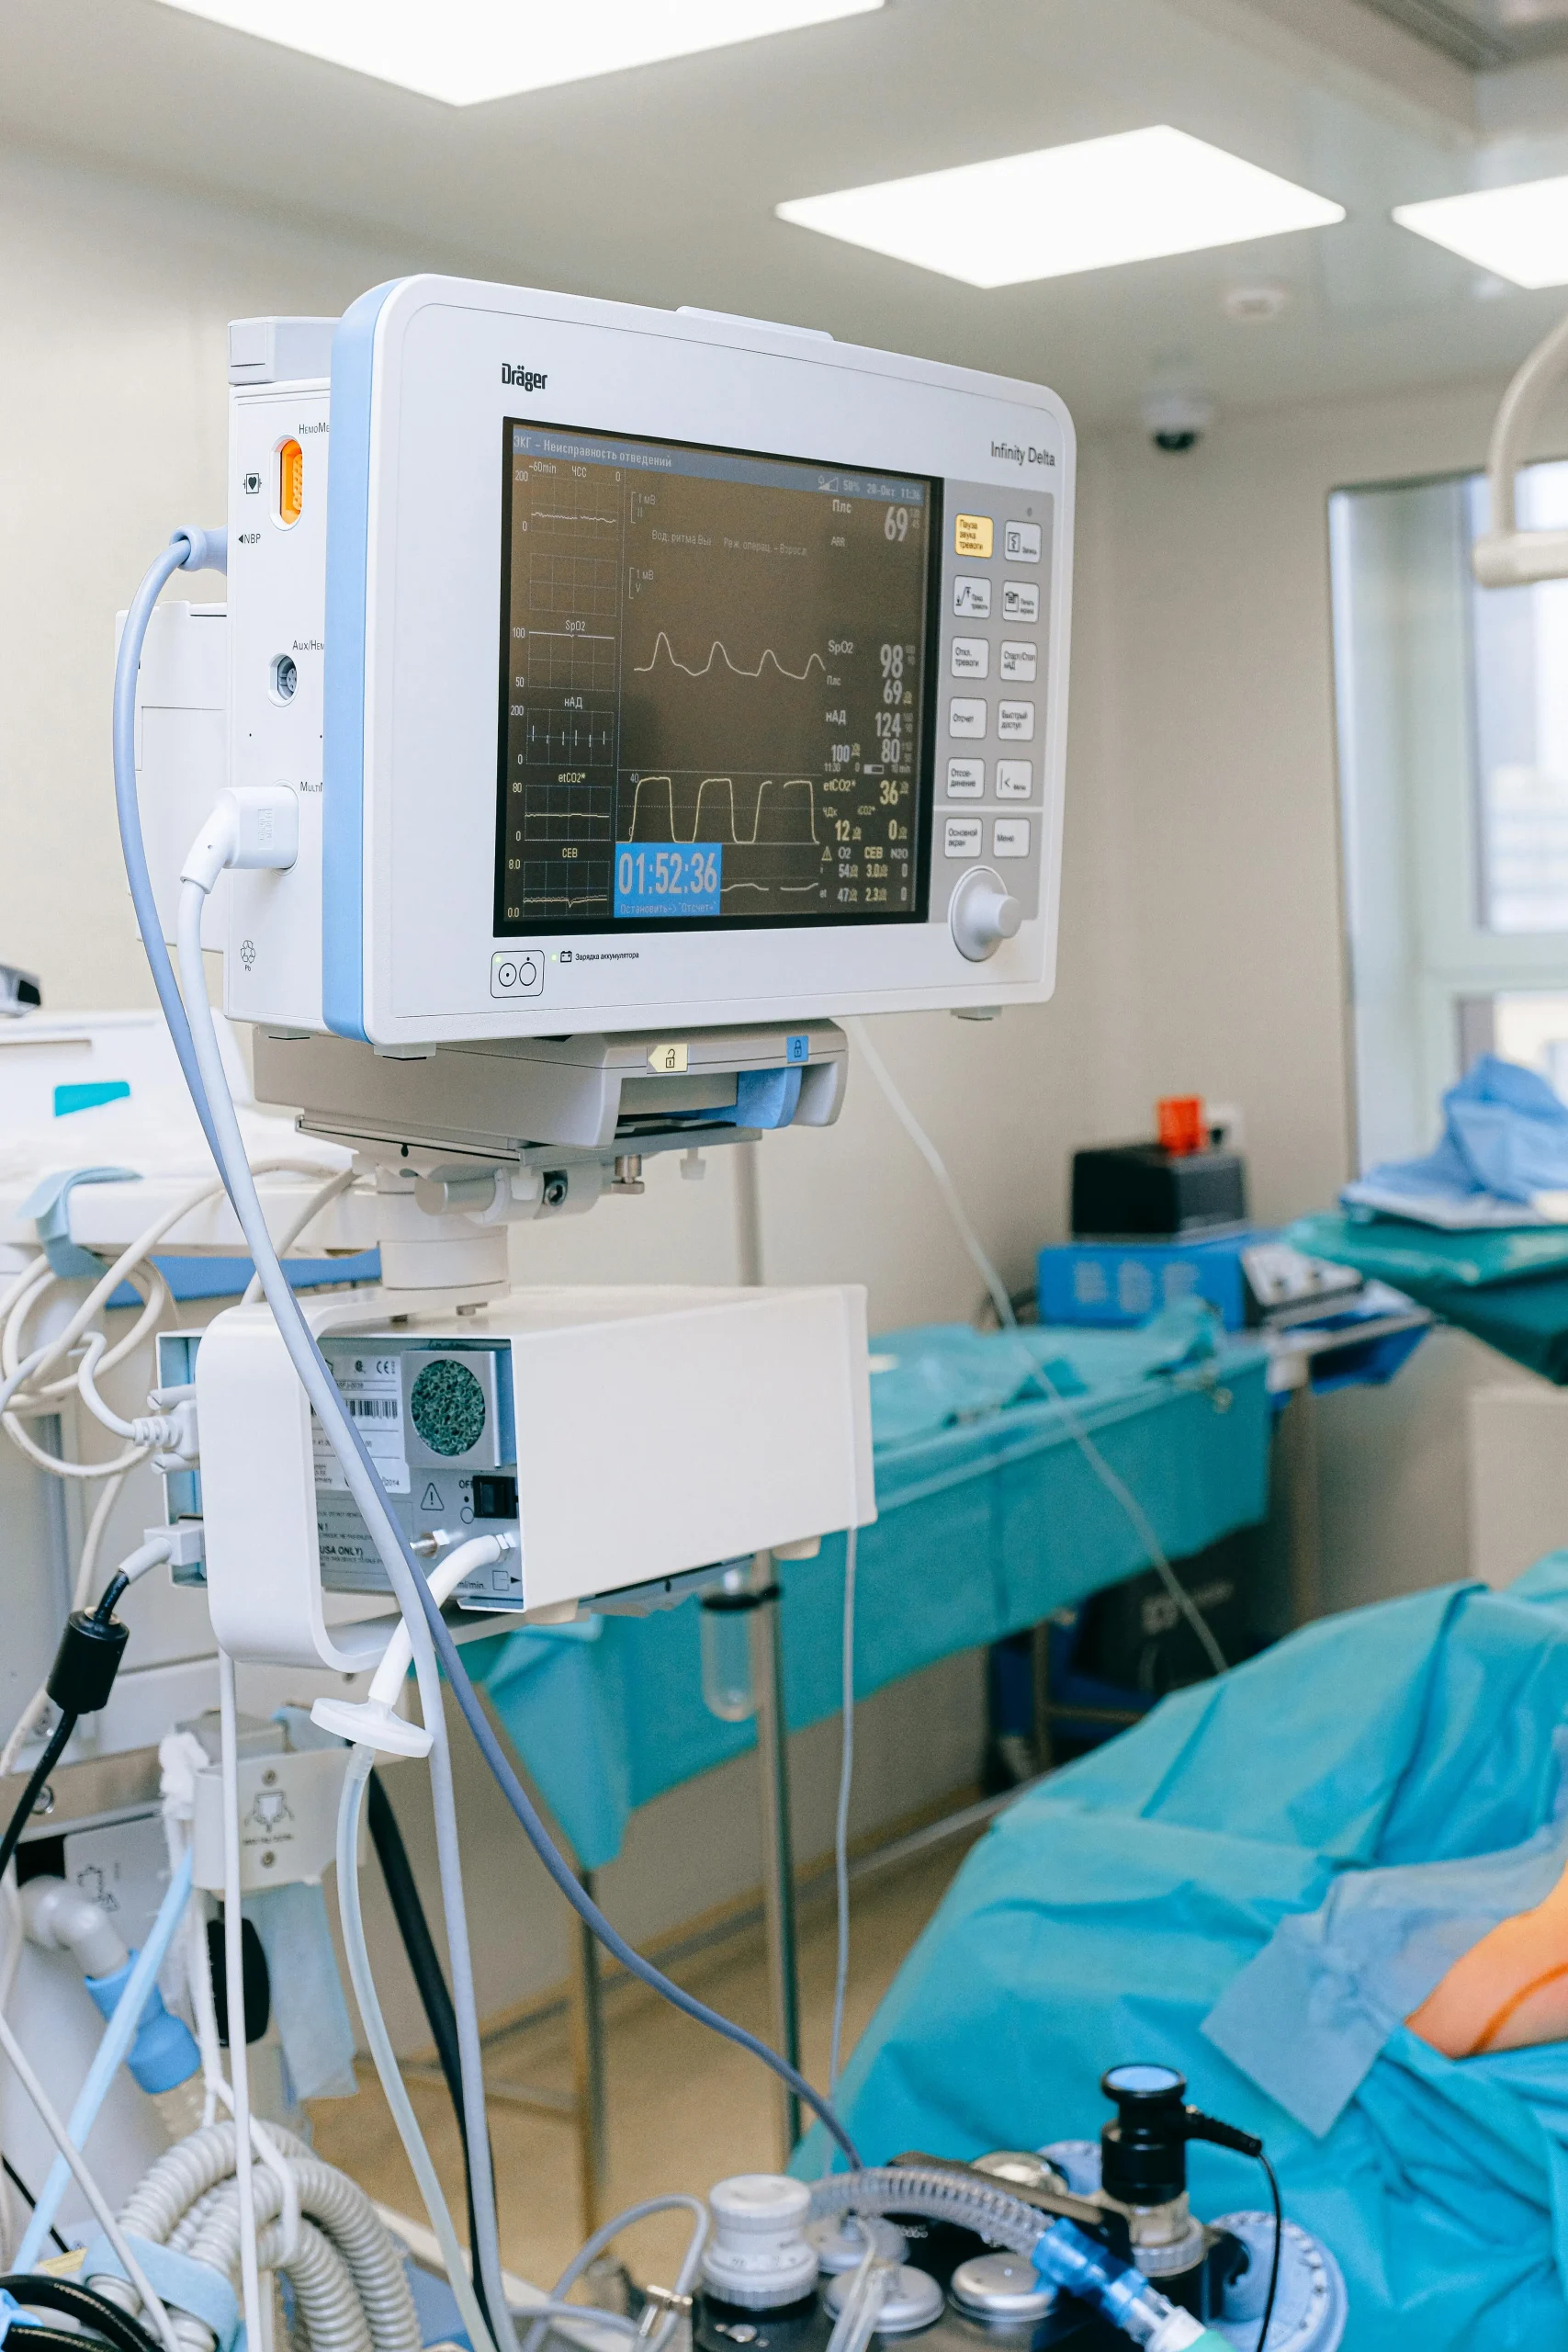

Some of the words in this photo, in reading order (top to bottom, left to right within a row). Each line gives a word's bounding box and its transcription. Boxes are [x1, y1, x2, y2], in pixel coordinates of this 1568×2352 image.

[502, 363, 548, 392] Dräger
[513, 435, 532, 448] ЭКГ
[544, 439, 617, 459] Неисправность
[619, 451, 671, 468] отведений
[990, 441, 1025, 466] Infinity
[1028, 447, 1056, 467] Delta
[514, 470, 529, 482] 200
[571, 466, 587, 478] ЧСС
[615, 471, 621, 482] 0
[643, 494, 656, 505] мВ
[832, 499, 852, 514] Плс
[522, 520, 528, 532] 0
[884, 505, 908, 542] 69
[959, 519, 978, 530] Пауза
[243, 533, 262, 545] NBP
[671, 532, 697, 545] ритма
[959, 531, 977, 540] звука
[959, 541, 984, 550] тревоги
[642, 570, 654, 581] мВ
[565, 619, 586, 632] SpO2
[512, 628, 525, 639] 100
[828, 639, 853, 655] SpO2
[880, 643, 904, 679] 98
[515, 676, 525, 687] 50
[883, 679, 903, 705] 69
[564, 696, 583, 709] нАД
[510, 705, 525, 716] 200
[1001, 709, 1028, 720] Быстрый
[825, 709, 847, 725] нАД
[874, 711, 902, 738] 124
[1000, 721, 1022, 730] доступ
[830, 744, 851, 763] 100
[881, 738, 901, 763] 80
[517, 753, 524, 765] 0
[513, 782, 523, 793] 80
[879, 779, 899, 805] 36
[834, 819, 851, 842] 12
[888, 819, 897, 841] 0
[948, 828, 978, 837] Основной
[515, 831, 522, 842] 0
[838, 846, 852, 860] O2
[890, 847, 908, 860] N2O
[508, 859, 521, 870] 8.0
[838, 863, 850, 878] 54
[618, 853, 717, 895] 01:52:36
[837, 887, 850, 902] 47
[865, 887, 879, 902] 2.3
[507, 907, 520, 918] 0.0
[575, 953, 600, 961] Зарядка
[600, 952, 639, 960] аккумулятора
[244, 964, 252, 972] Pb
